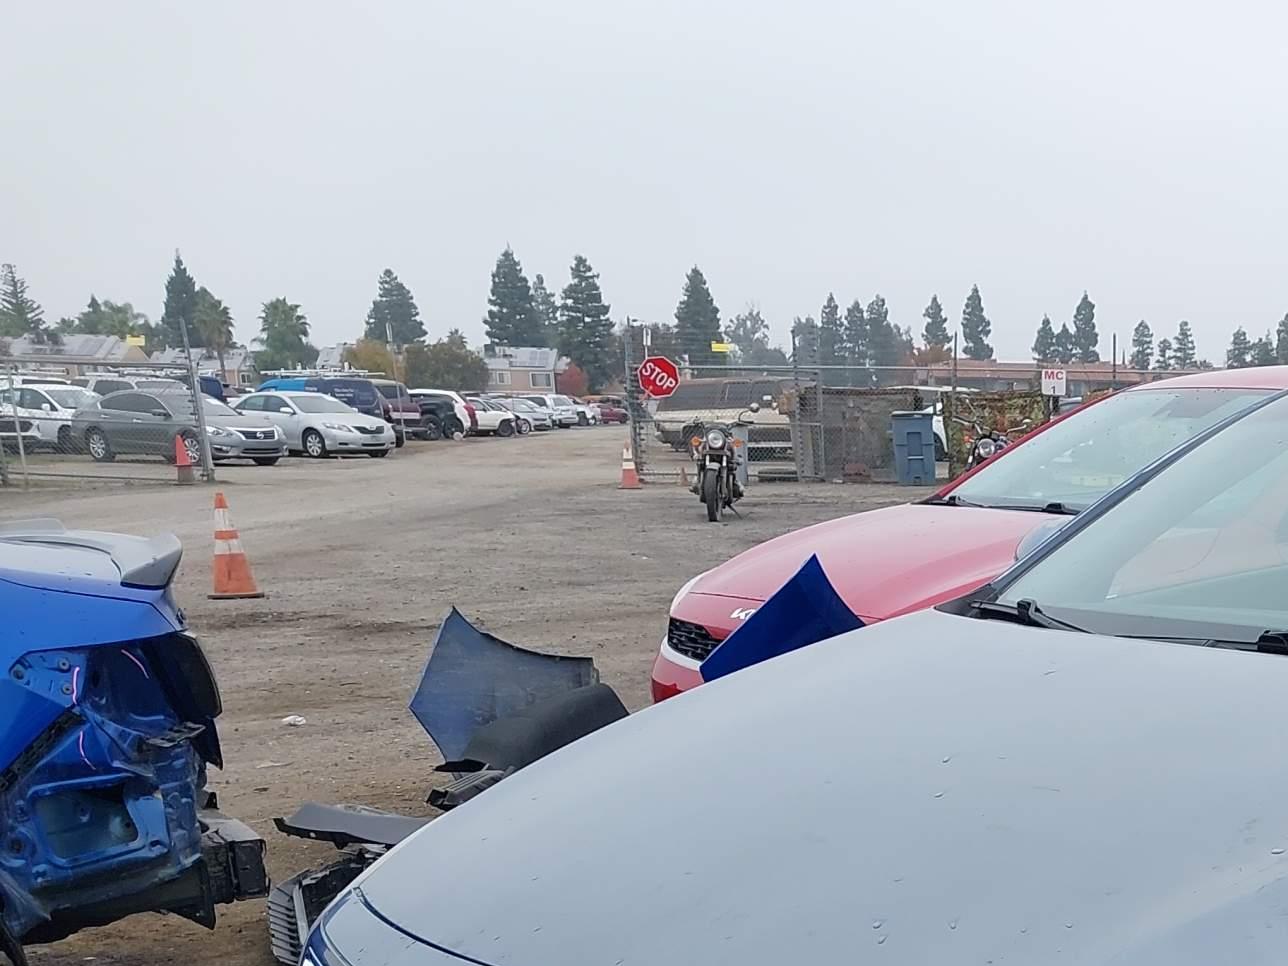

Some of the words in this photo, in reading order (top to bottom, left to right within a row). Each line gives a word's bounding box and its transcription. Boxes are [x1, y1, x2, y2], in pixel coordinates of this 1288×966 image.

[642, 362, 676, 389] STOP
[1044, 371, 1064, 380] MC
[1051, 386, 1056, 394] 1
